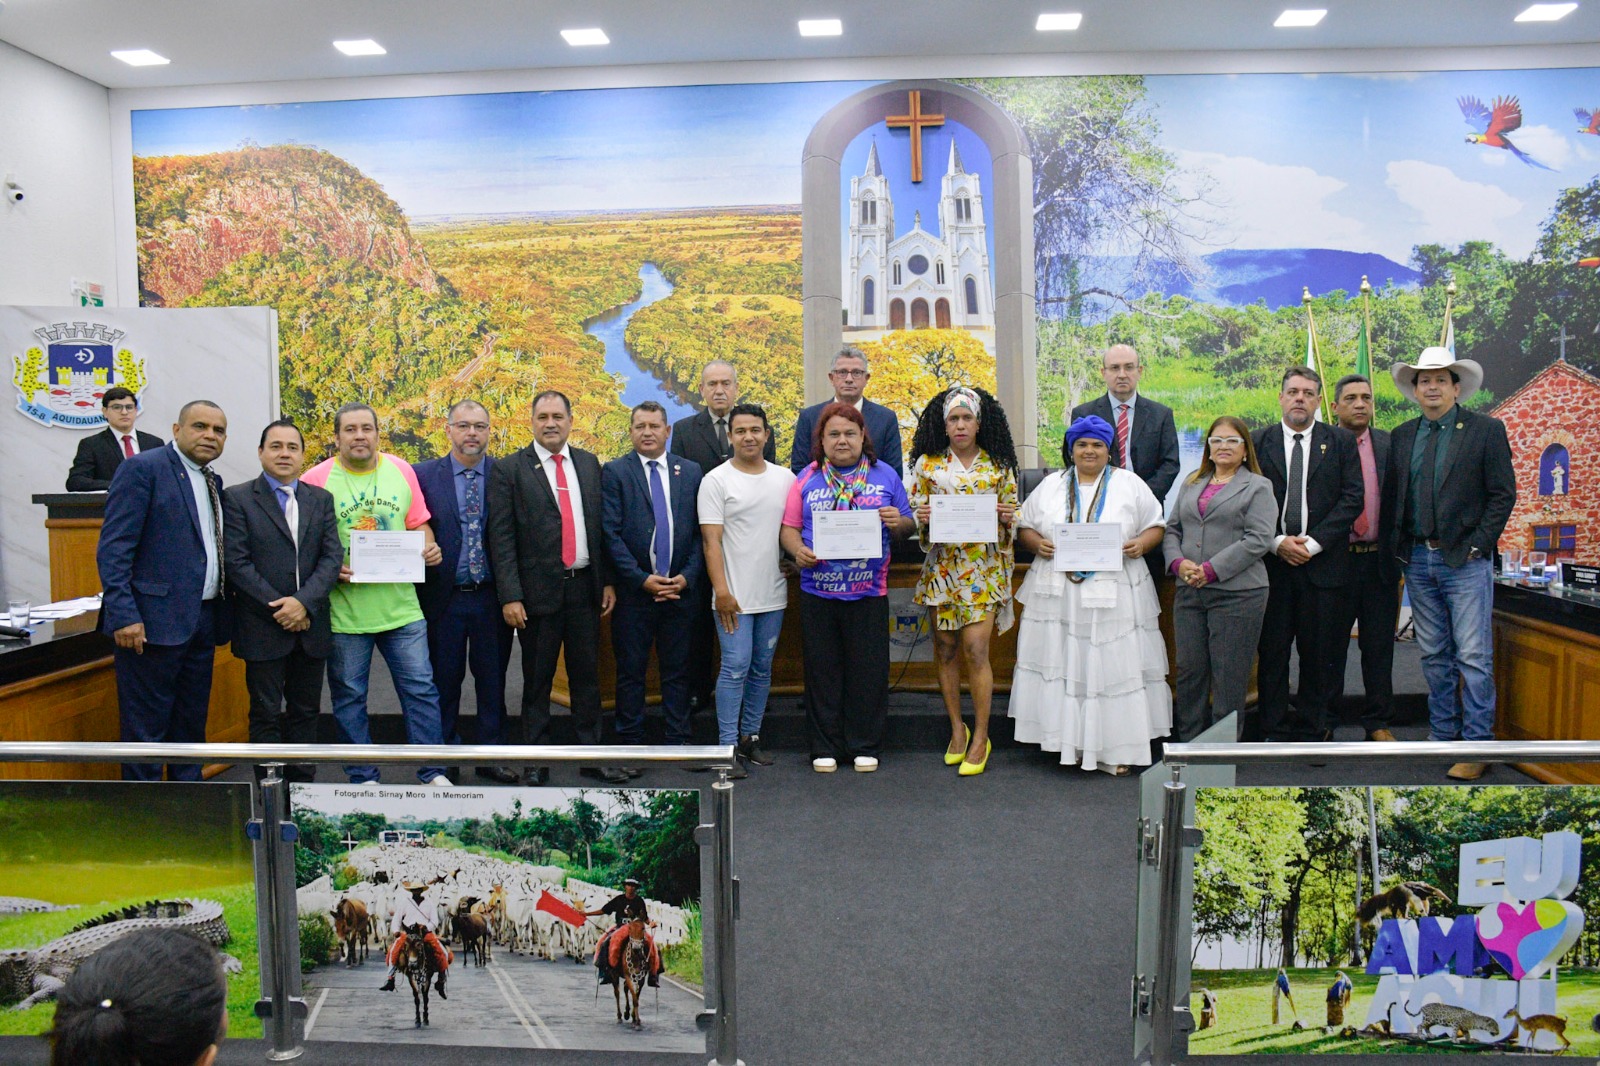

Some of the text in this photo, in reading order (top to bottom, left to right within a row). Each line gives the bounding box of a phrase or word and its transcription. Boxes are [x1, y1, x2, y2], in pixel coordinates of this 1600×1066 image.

[26, 405, 46, 420] 15-8
[52, 413, 108, 425] AQUIDAUAN
[340, 503, 362, 518] Grupo
[377, 498, 400, 512] Dança
[812, 570, 873, 582] NOSSA LUTA
[823, 583, 846, 592] PELA
[334, 789, 377, 800] Fotografia:
[379, 790, 403, 800] Sirnay
[405, 791, 426, 799] Moro
[1458, 832, 1582, 906] EU
